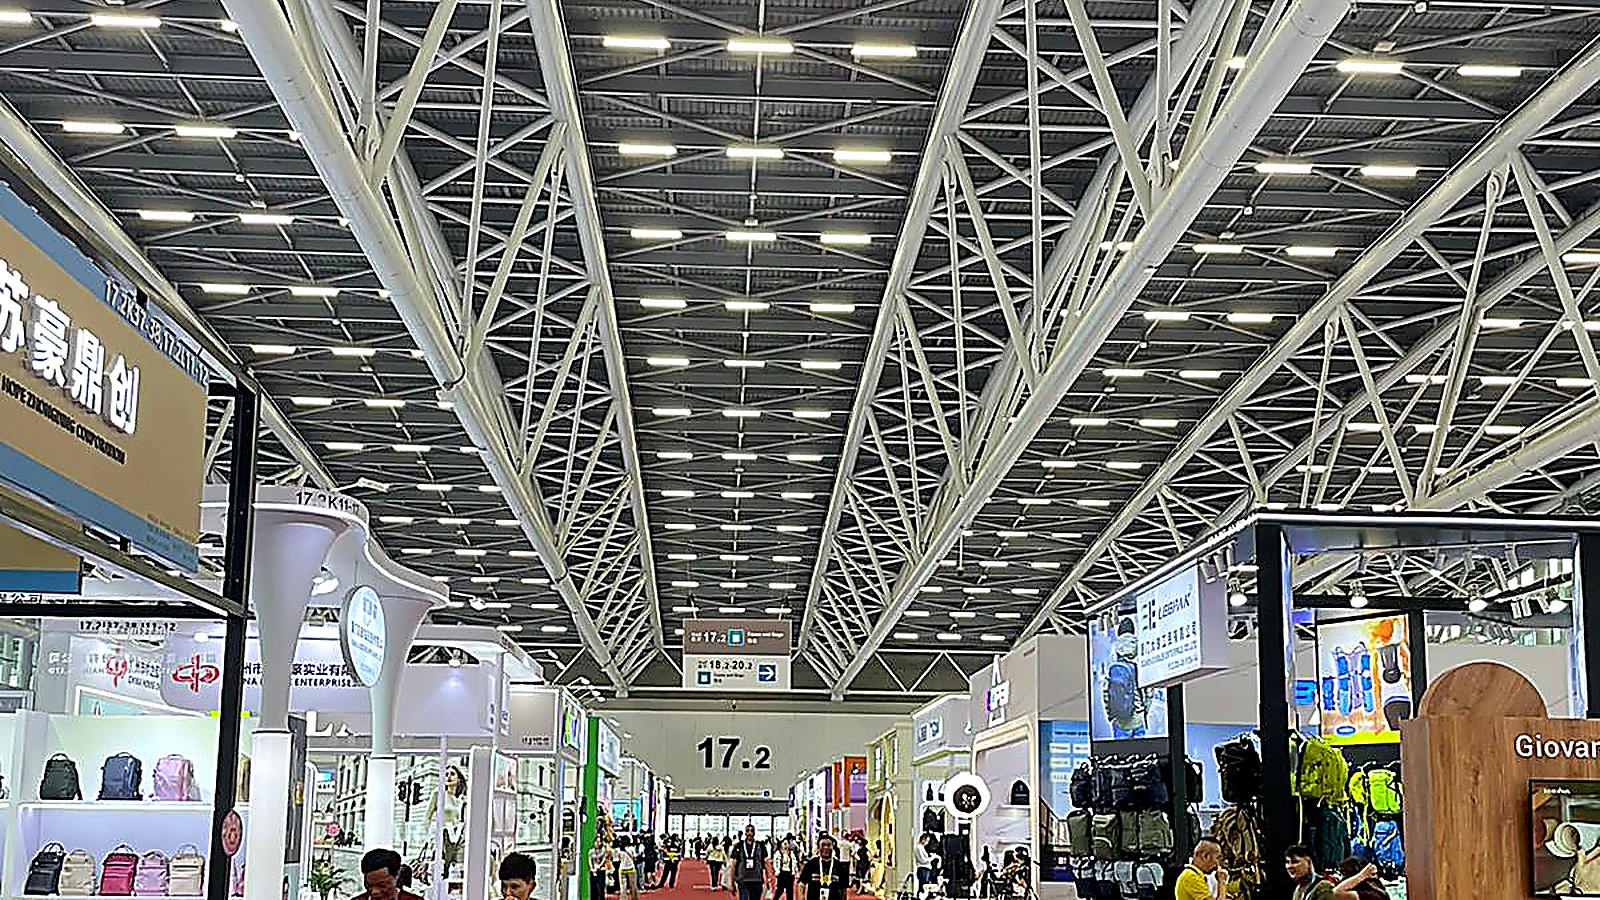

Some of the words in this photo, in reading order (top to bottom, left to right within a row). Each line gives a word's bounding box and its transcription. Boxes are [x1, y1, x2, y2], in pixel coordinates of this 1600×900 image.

[0, 258, 140, 434] 苏豪鼎创
[697, 736, 771, 769] 17.2
